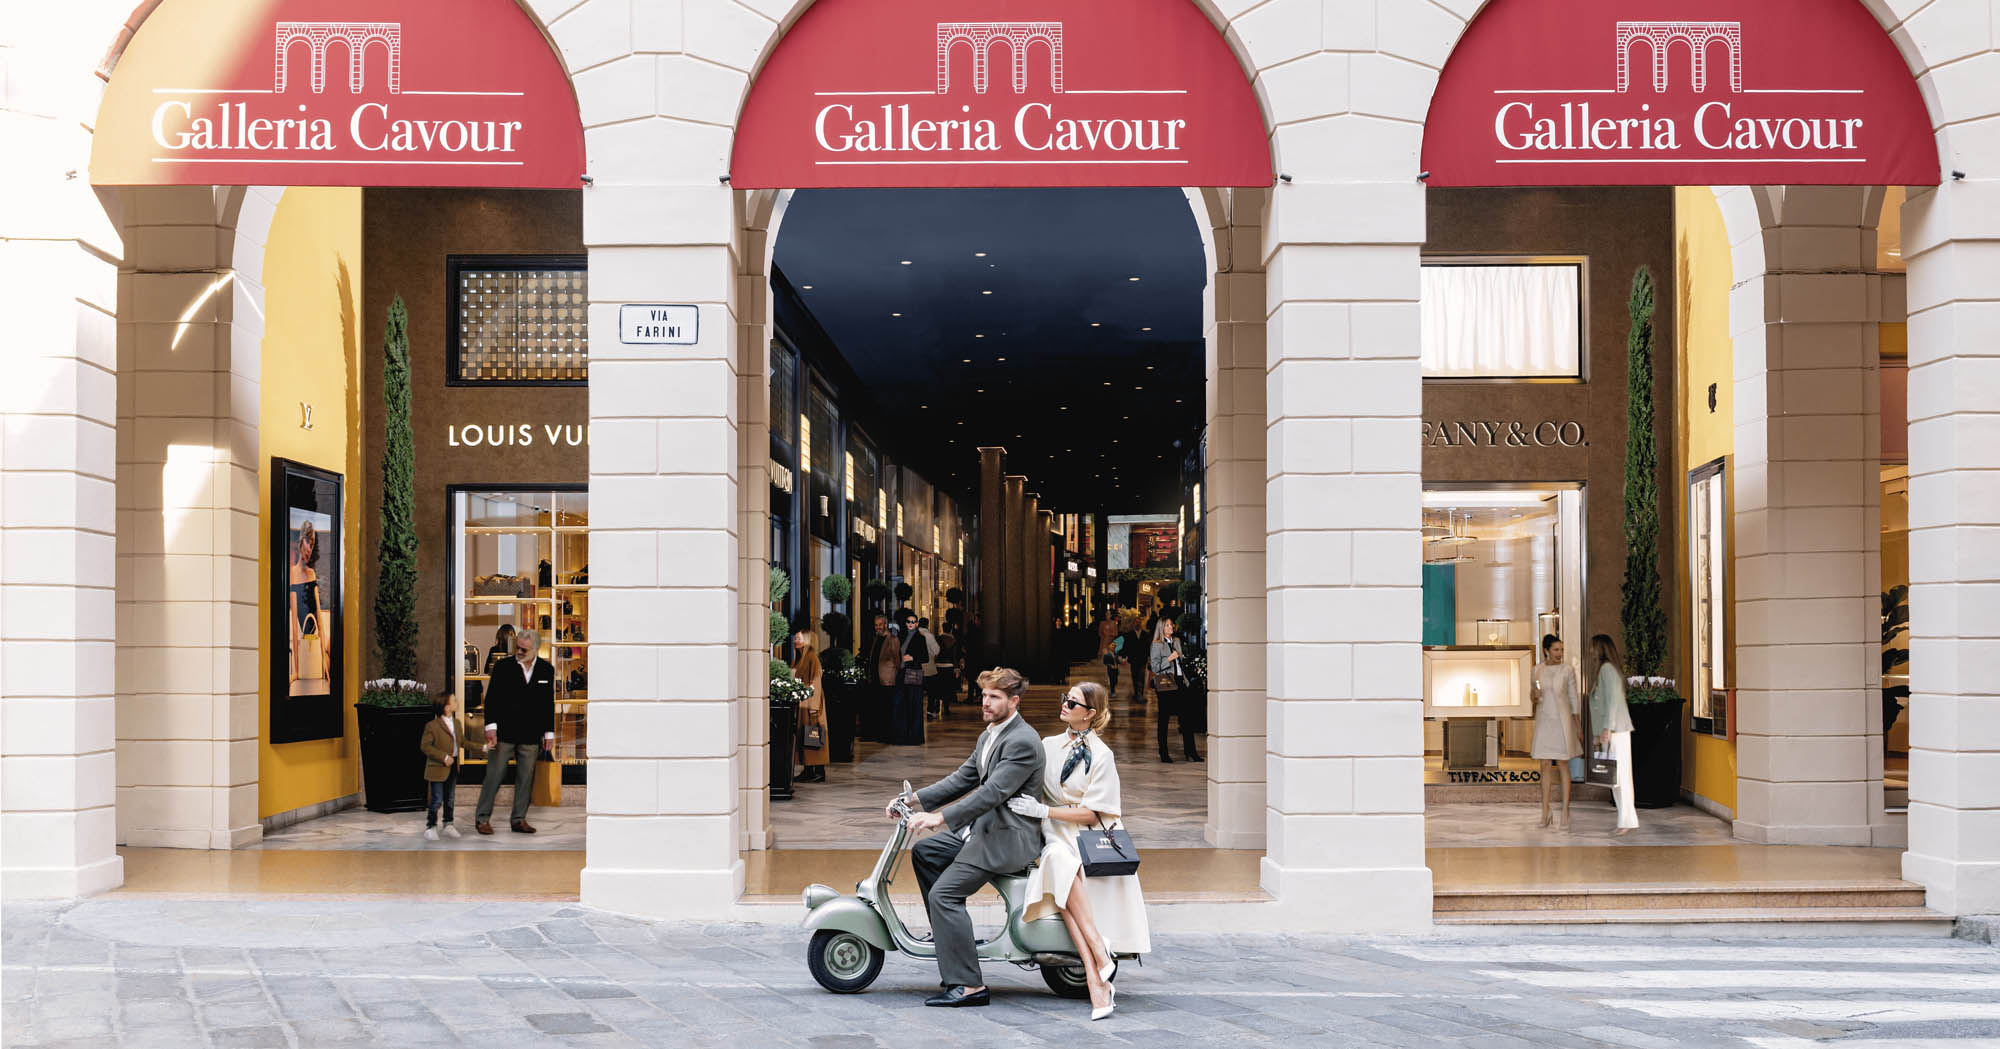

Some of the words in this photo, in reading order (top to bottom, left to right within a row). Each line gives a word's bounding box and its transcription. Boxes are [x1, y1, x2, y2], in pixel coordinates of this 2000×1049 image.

[152, 101, 336, 150] Galleria
[350, 103, 522, 152] Cavour
[815, 104, 1001, 151] Galleria
[1014, 103, 1186, 151] Cavour
[1495, 102, 1681, 150] Galleria
[1694, 102, 1863, 150] Cavour
[637, 326, 681, 338] FARINI
[651, 310, 668, 321] VIA
[449, 424, 533, 447] LOUIS
[544, 424, 589, 447] VU
